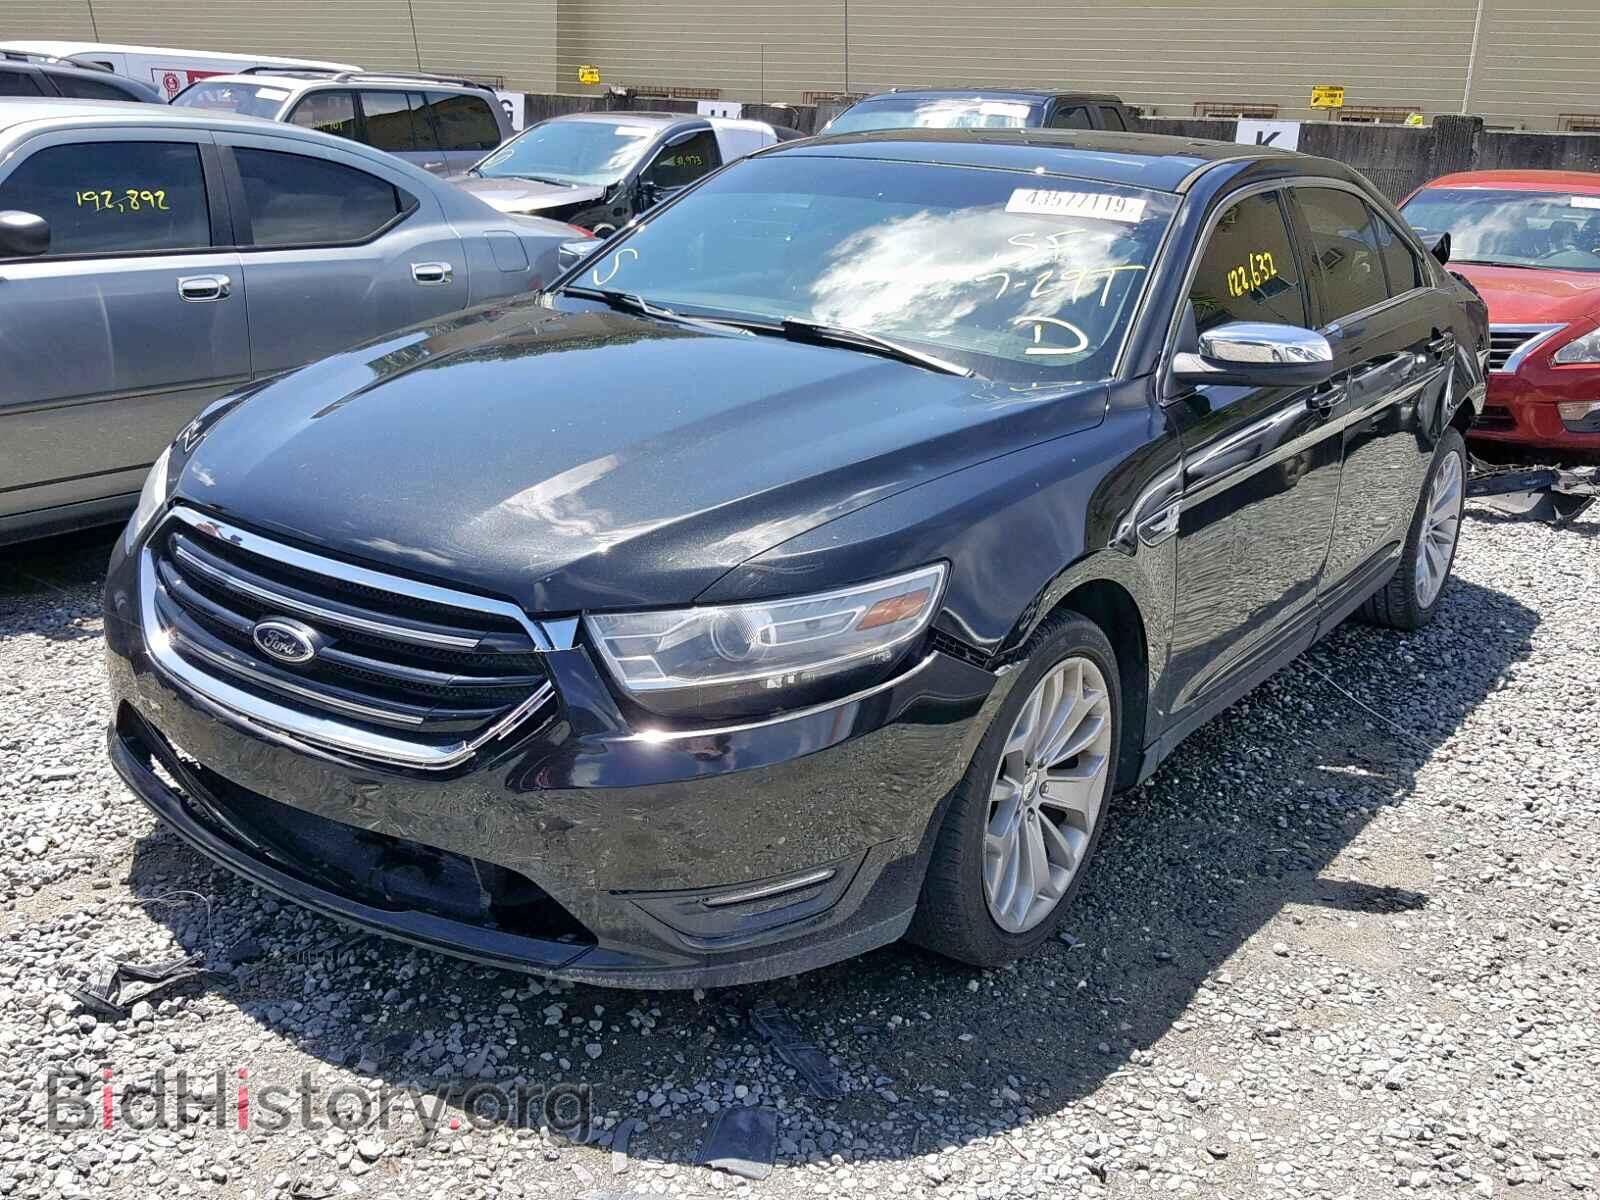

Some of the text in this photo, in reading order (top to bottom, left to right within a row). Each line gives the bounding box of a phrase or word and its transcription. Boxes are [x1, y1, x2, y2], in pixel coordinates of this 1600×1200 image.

[76, 189, 171, 213] 192,892
[1225, 251, 1279, 298] 122,632
[1013, 315, 1090, 355] D
[263, 629, 297, 656] Ford
